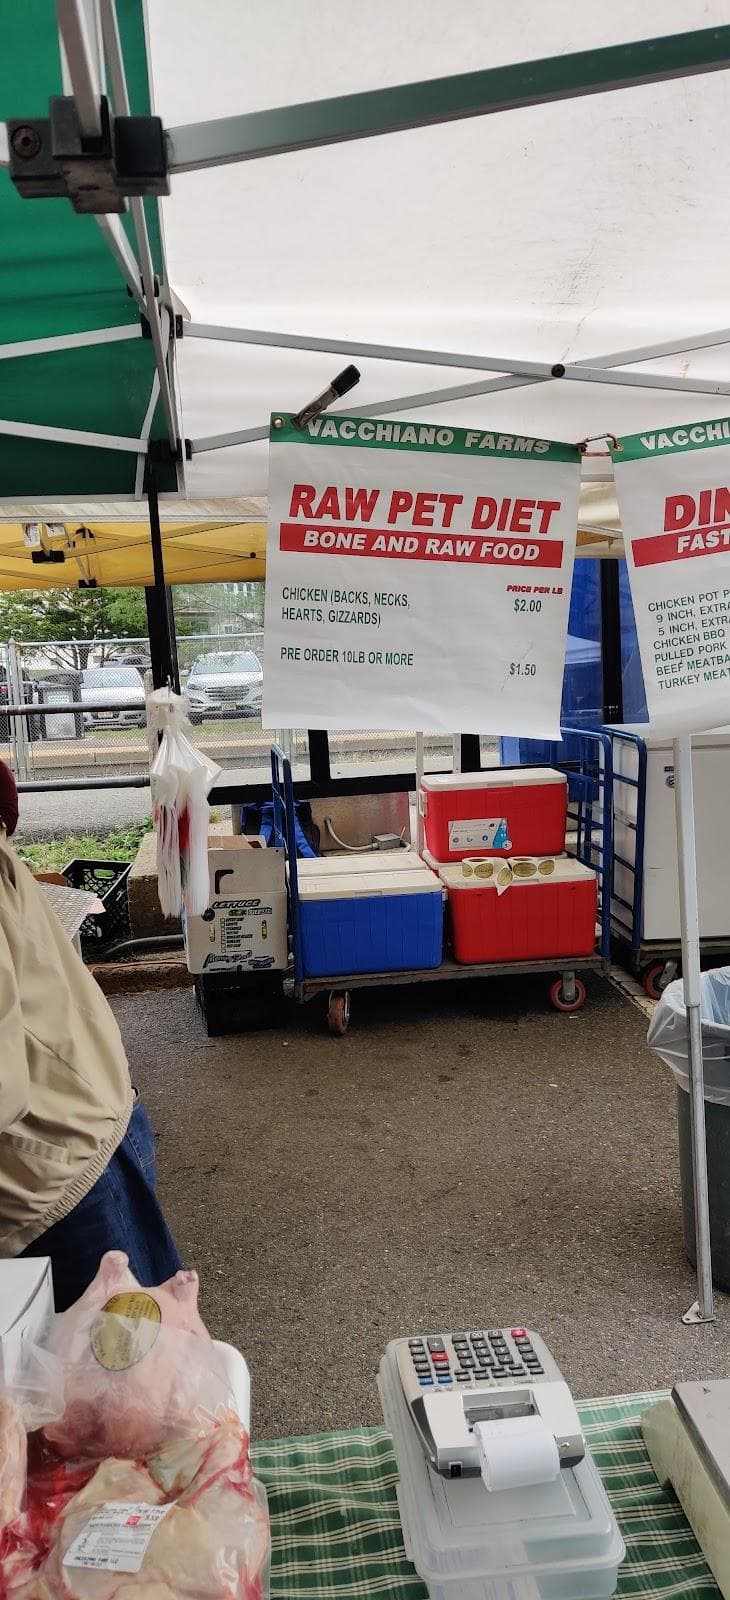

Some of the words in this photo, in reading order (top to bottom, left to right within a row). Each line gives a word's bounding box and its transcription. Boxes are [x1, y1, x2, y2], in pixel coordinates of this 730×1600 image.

[305, 420, 454, 446] VACCHIANO
[464, 432, 551, 453] FARMS
[289, 484, 380, 522] RAW
[387, 490, 464, 527] PET
[471, 496, 561, 533] DIET
[304, 530, 365, 550] BONE
[372, 535, 418, 553] AND
[425, 538, 475, 556] RAW
[480, 542, 540, 561] FOOD
[282, 587, 328, 602] CHICKEN
[330, 590, 371, 606] (BACKS,
[374, 592, 410, 609] NECKS,
[507, 585, 532, 593] PRICE
[534, 586, 550, 594] PER
[552, 587, 563, 595] LB
[514, 598, 542, 613] $2.00
[648, 595, 695, 612] CHICKEN
[699, 590, 719, 603] POT
[282, 607, 325, 624] HEARTS,
[328, 610, 381, 629] GIZZARDS)
[656, 614, 663, 623] 9
[667, 609, 696, 621] INCH,
[658, 627, 665, 636] 5
[701, 615, 730, 628] EXTR
[653, 633, 700, 650] CHICKEN
[703, 629, 725, 641] BBQ
[280, 647, 301, 660] PRE
[303, 648, 339, 663] ORDER
[342, 650, 365, 664] 10LB
[368, 652, 383, 664] OR
[385, 652, 414, 666] MORE
[654, 648, 694, 663] PULLED
[698, 641, 727, 654] PORK
[509, 662, 536, 676] $1.50
[656, 662, 684, 676] BEEF
[658, 674, 700, 690] TURKEY
[212, 899, 260, 909] LETTUCE
